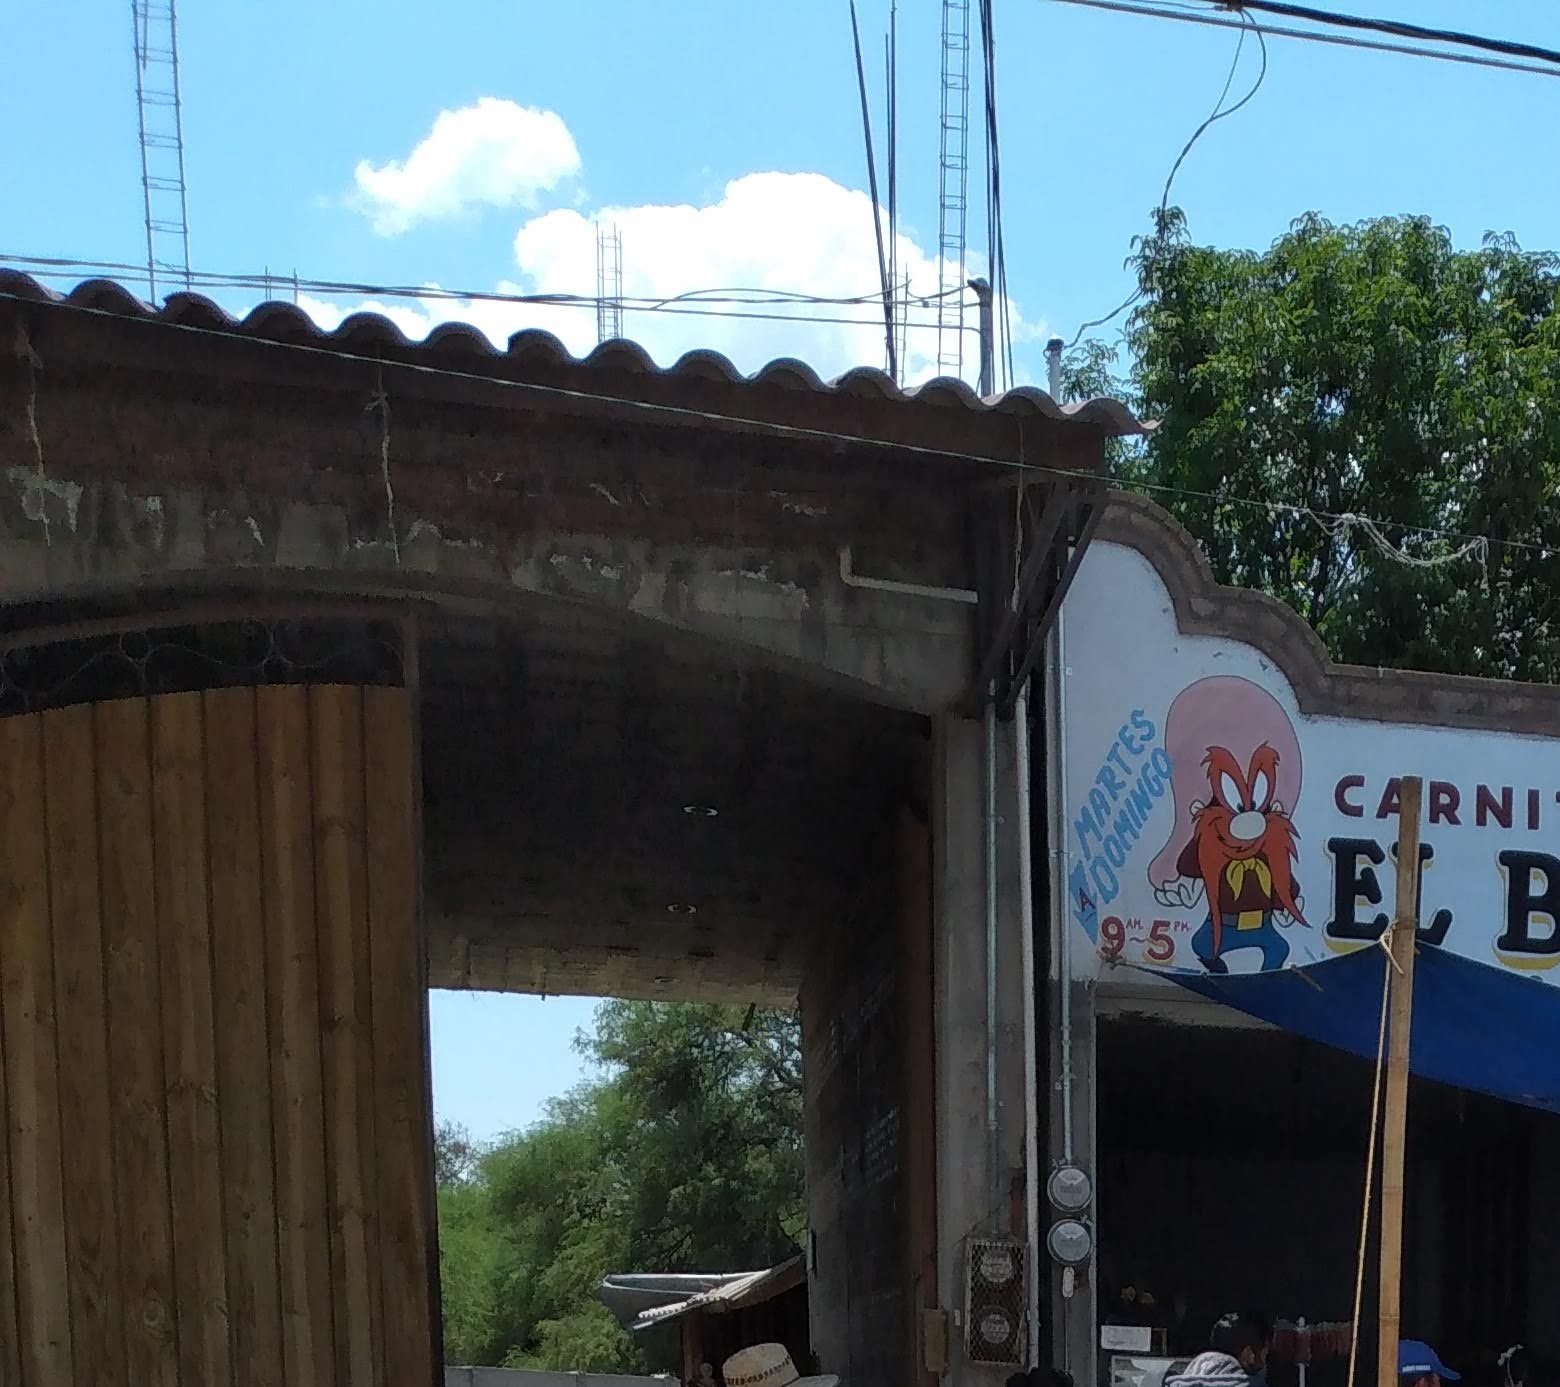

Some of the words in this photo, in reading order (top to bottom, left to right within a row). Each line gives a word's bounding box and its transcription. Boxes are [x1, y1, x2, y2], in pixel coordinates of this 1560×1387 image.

[1074, 708, 1155, 861] MARTES
[1090, 747, 1173, 904] DOMINGO
[1101, 916, 1125, 959] 9
[1147, 919, 1175, 961] 5
[1326, 837, 1453, 945] EL
